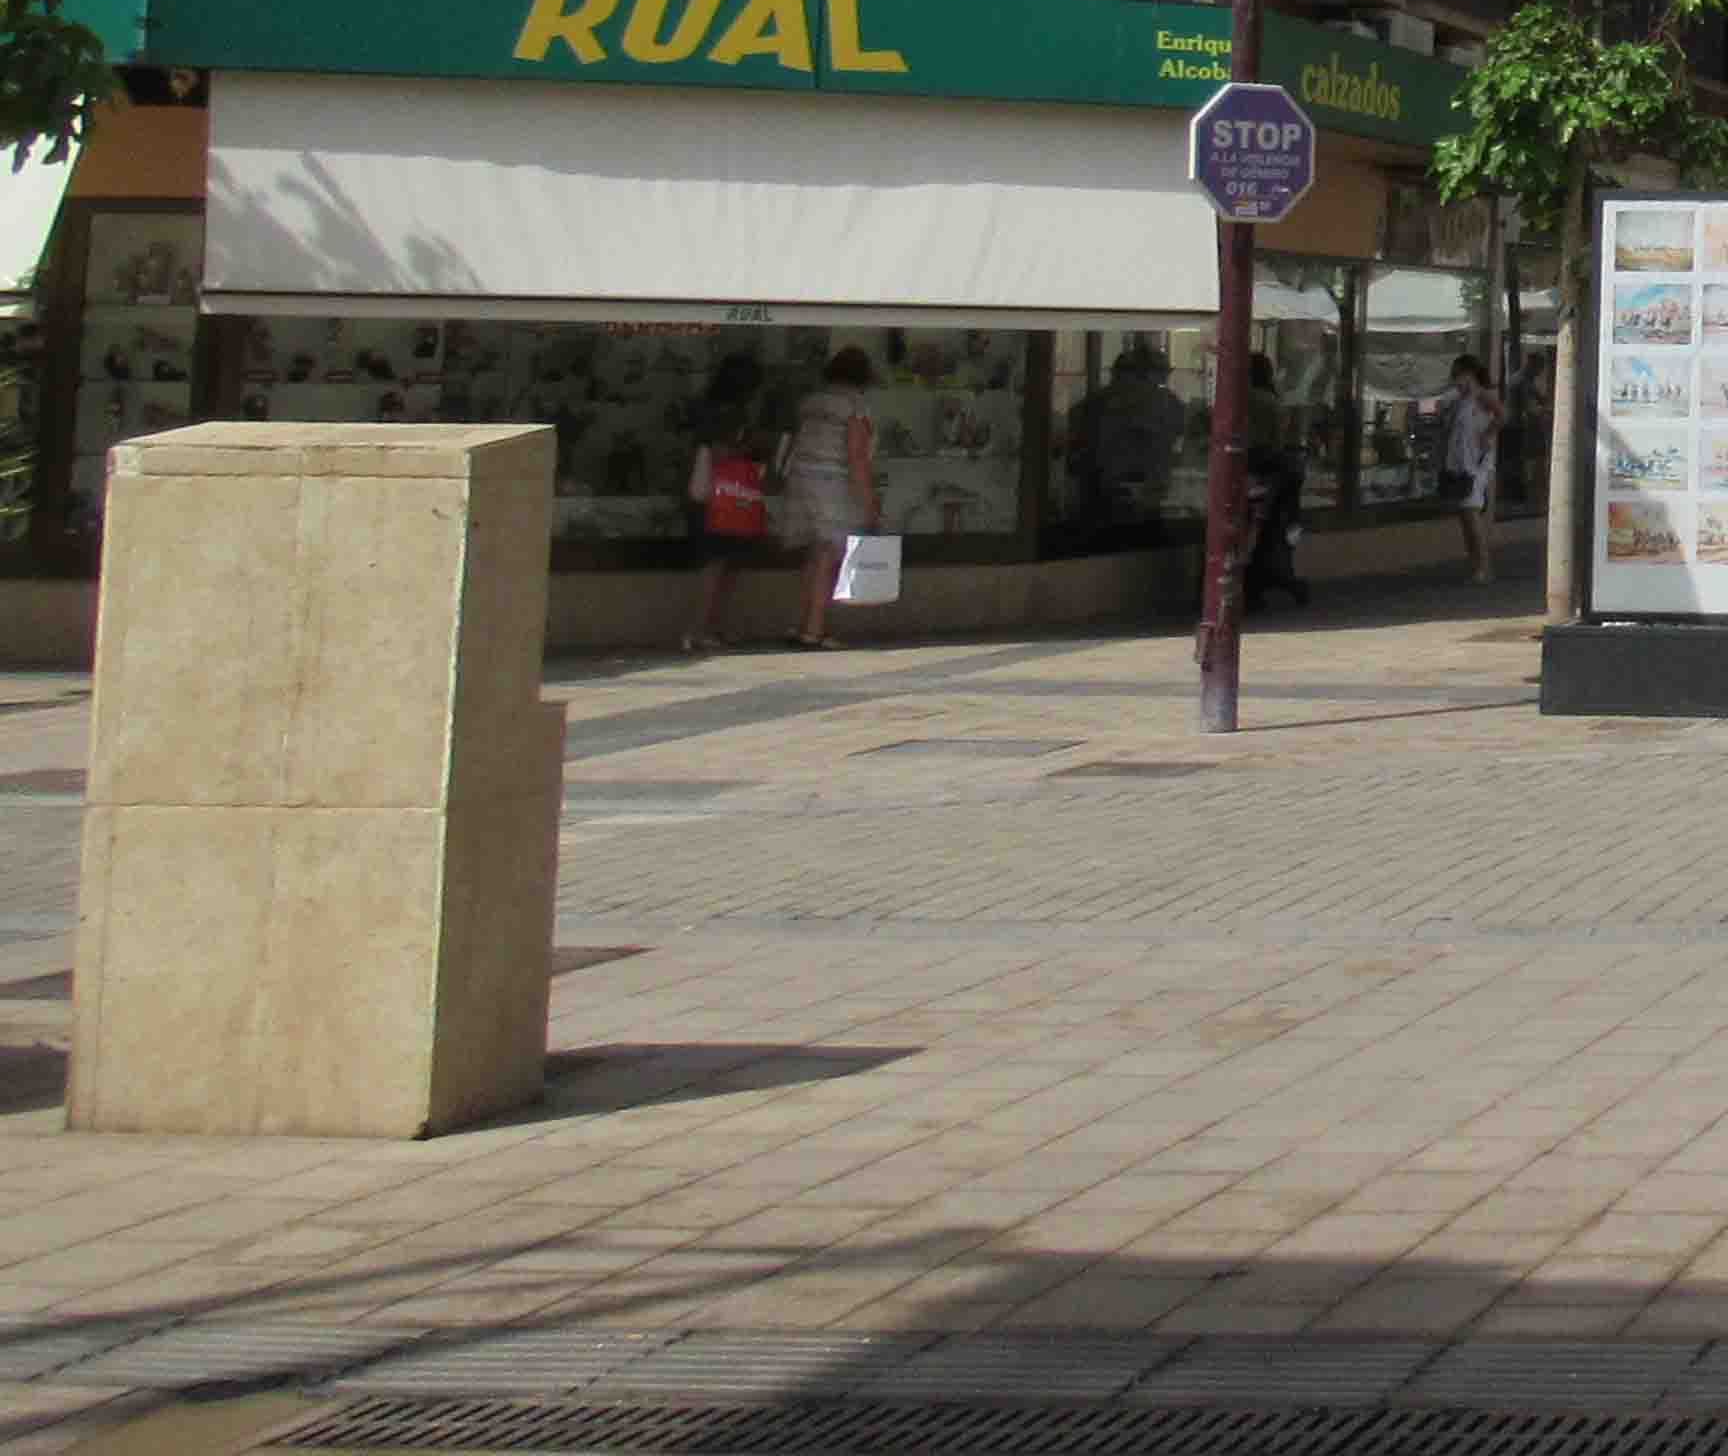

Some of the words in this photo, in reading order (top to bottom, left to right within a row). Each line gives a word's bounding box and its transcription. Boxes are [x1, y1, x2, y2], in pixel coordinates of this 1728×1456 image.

[1156, 30, 1233, 57] Enriqu
[1159, 58, 1232, 81] Alcob
[1301, 52, 1402, 121] calzados
[1212, 120, 1303, 151] STOP
